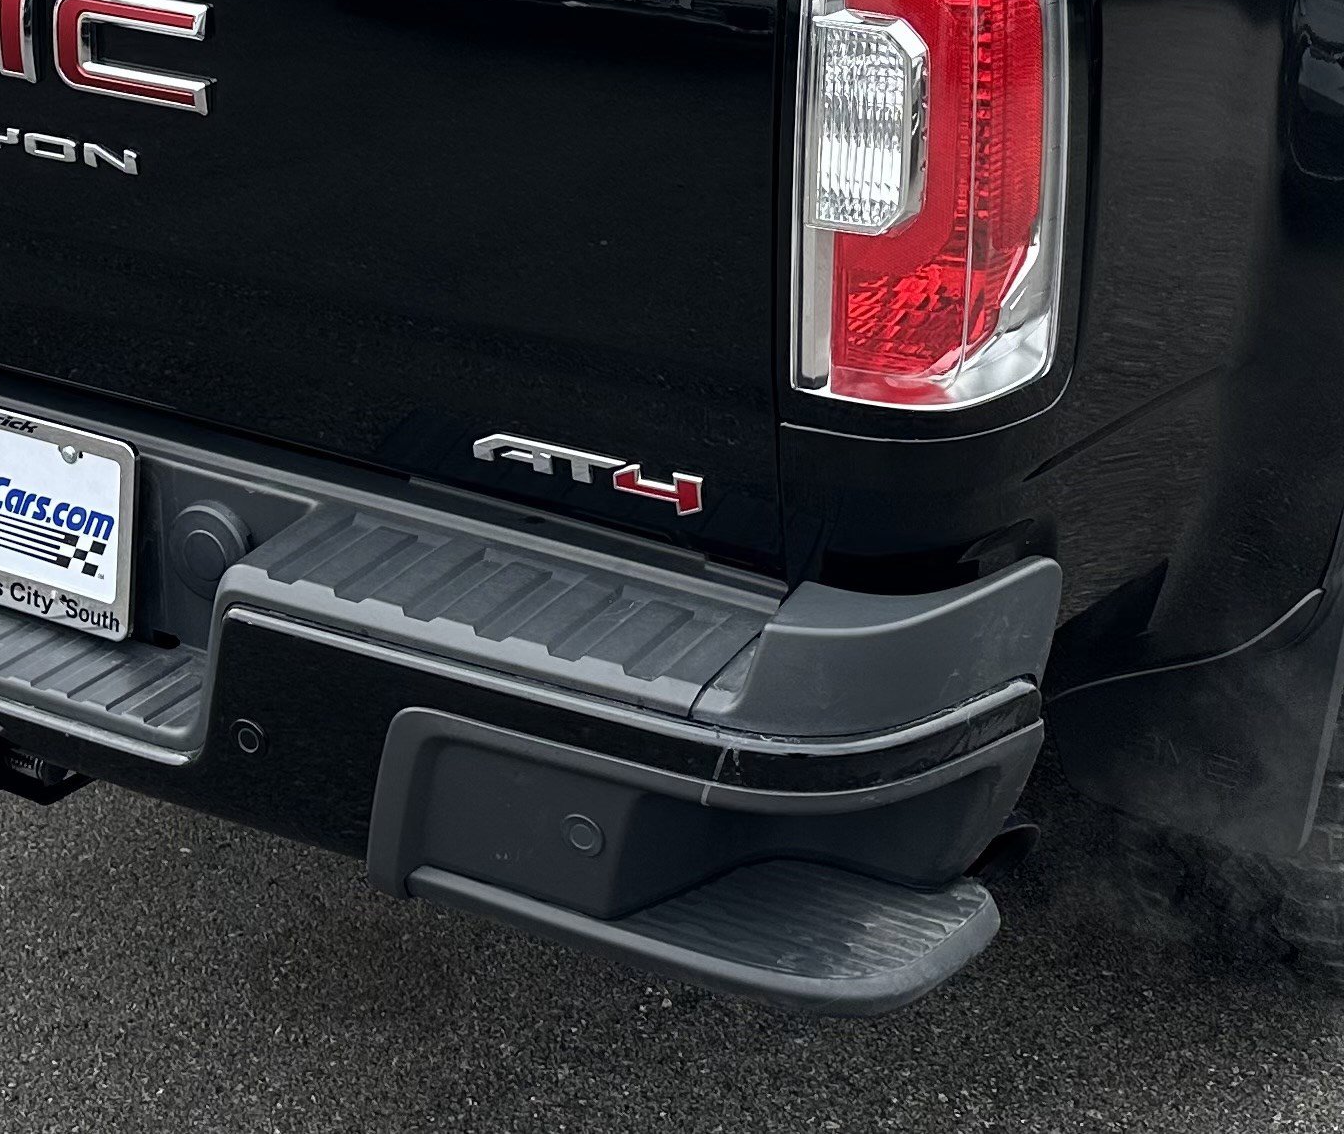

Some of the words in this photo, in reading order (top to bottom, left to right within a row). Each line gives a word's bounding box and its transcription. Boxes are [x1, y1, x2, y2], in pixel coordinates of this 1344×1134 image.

[472, 433, 704, 516] AT4
[10, 582, 54, 615] City
[66, 598, 121, 633] South
